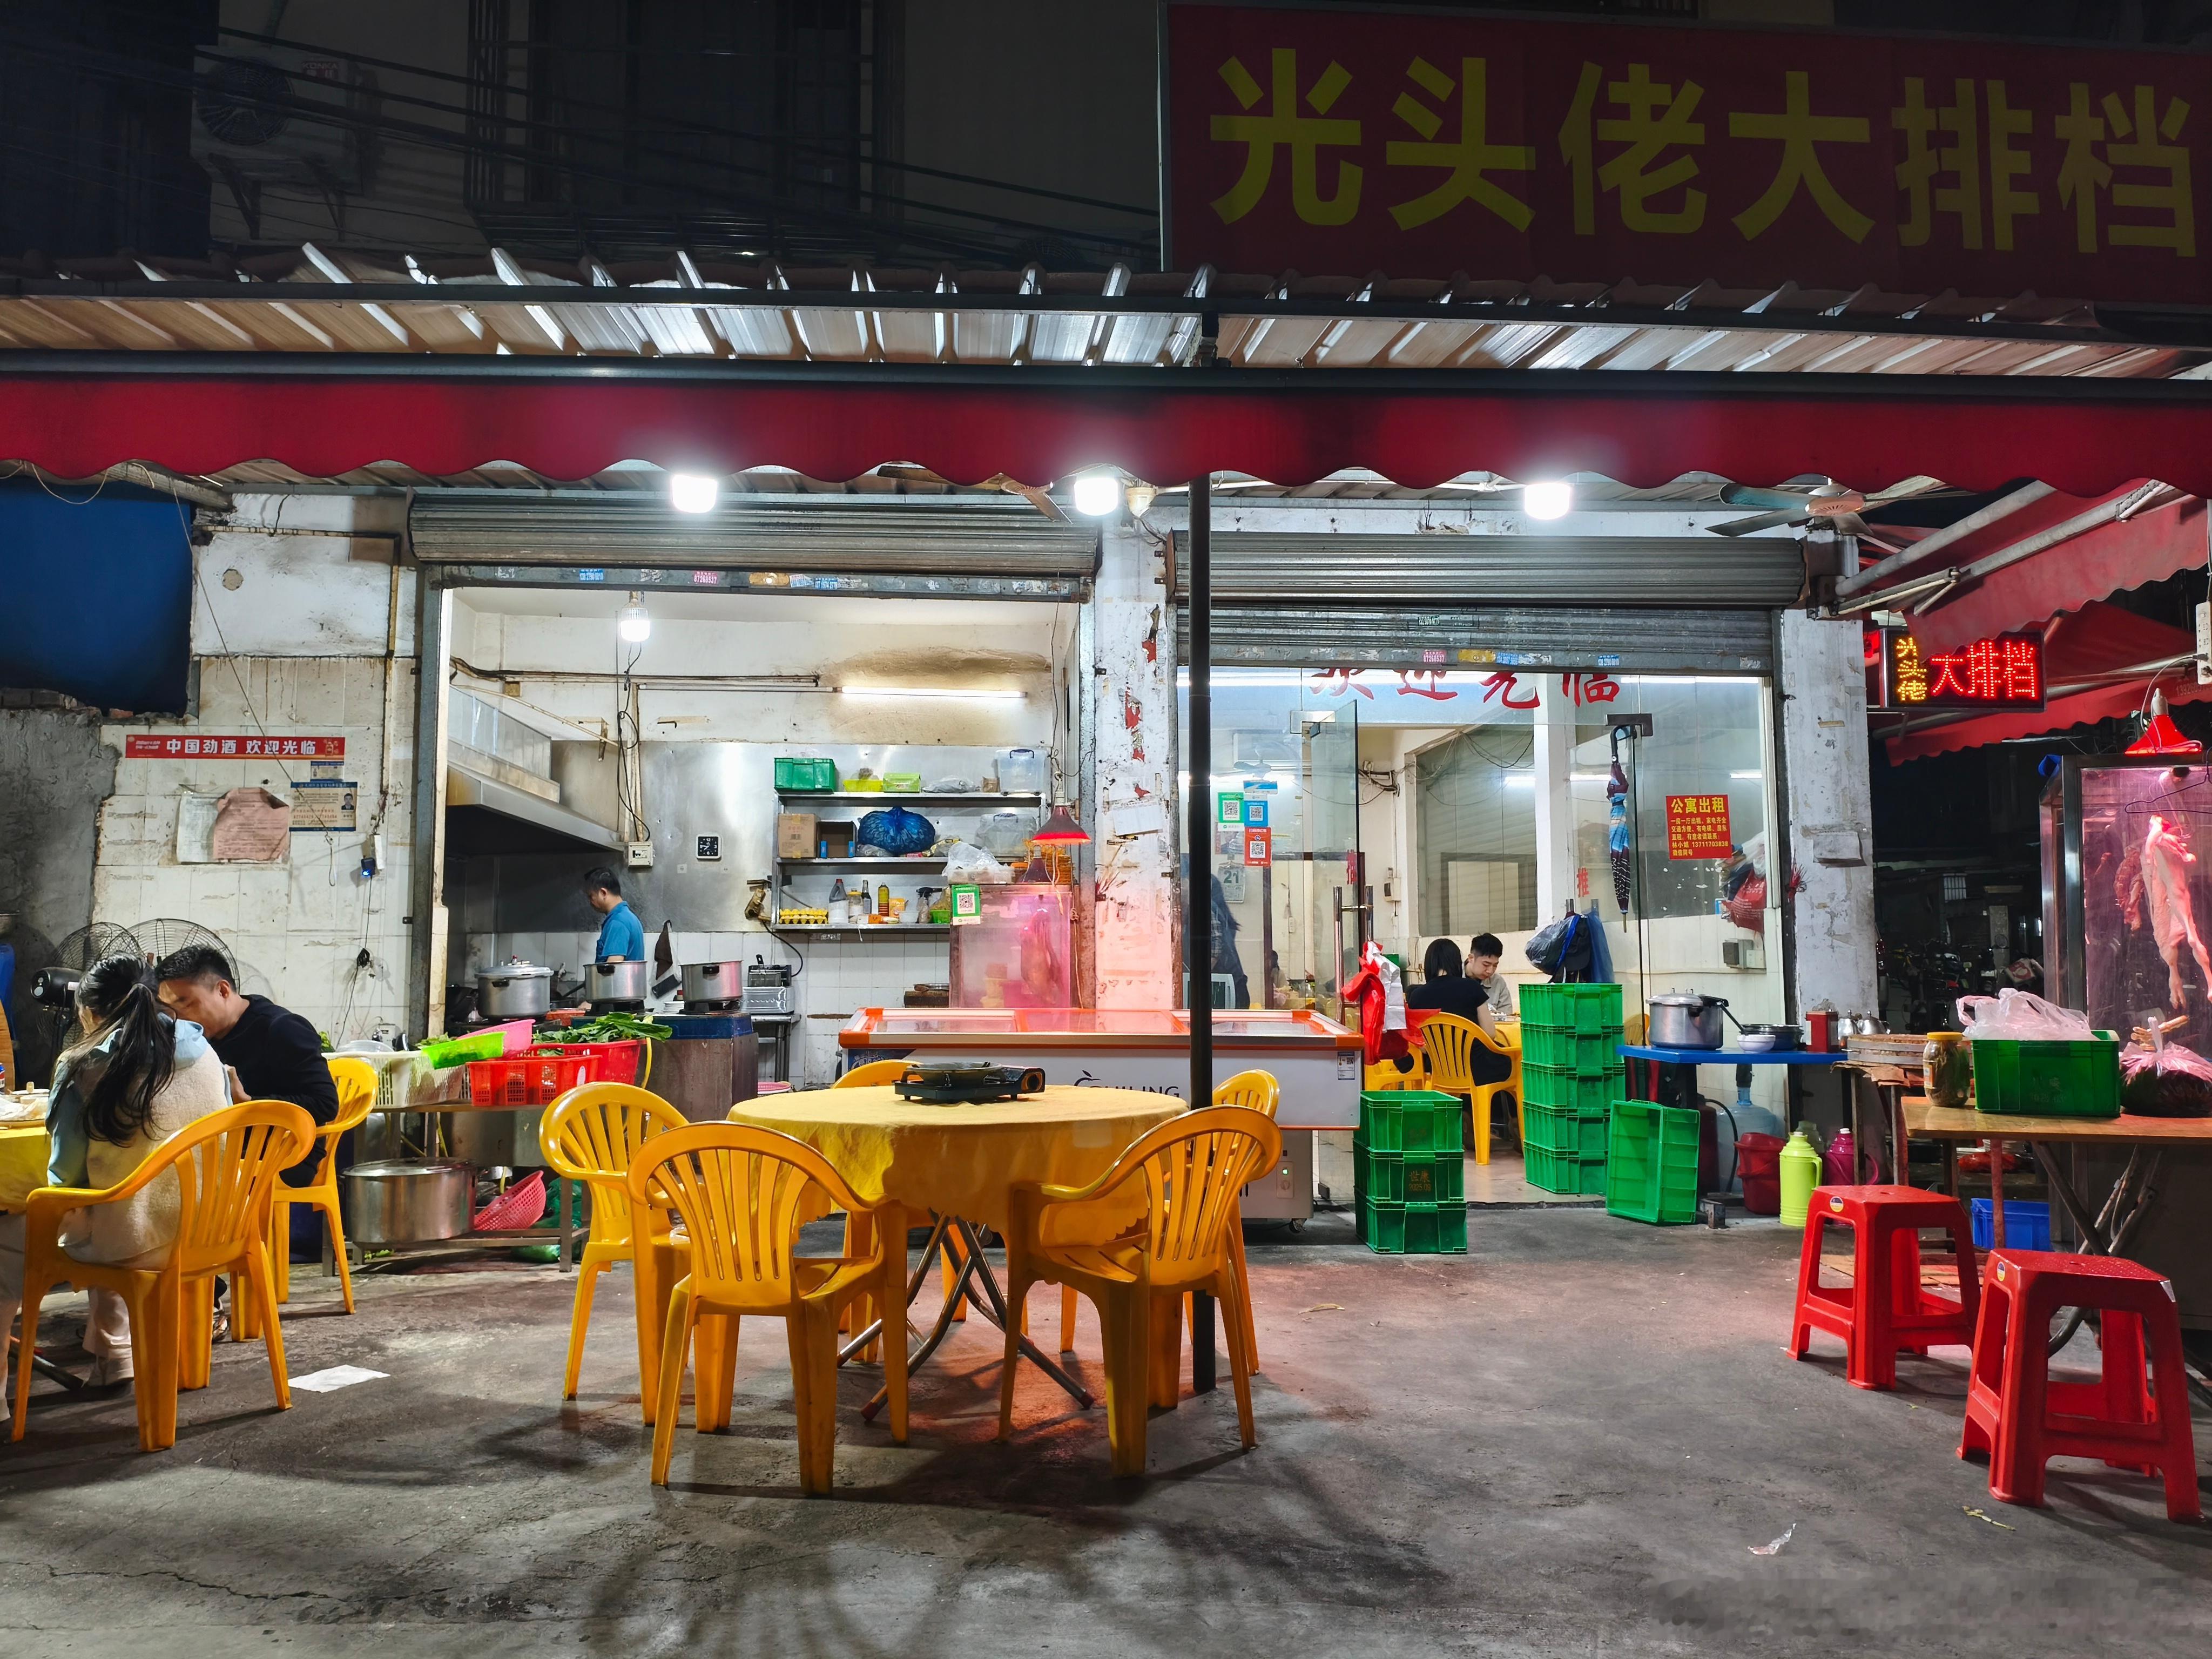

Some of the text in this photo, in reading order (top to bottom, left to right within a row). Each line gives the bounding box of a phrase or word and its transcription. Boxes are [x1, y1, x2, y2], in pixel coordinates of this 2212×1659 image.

[1210, 46, 2196, 258] 光头佬大排档
[1931, 641, 2035, 697] 大排档
[166, 739, 237, 754] 中国劲酒
[246, 739, 316, 755] 欢迎光临
[1671, 797, 1725, 814] 公寓出租
[1223, 870, 1239, 884] 21
[1576, 867, 1590, 898] 推
